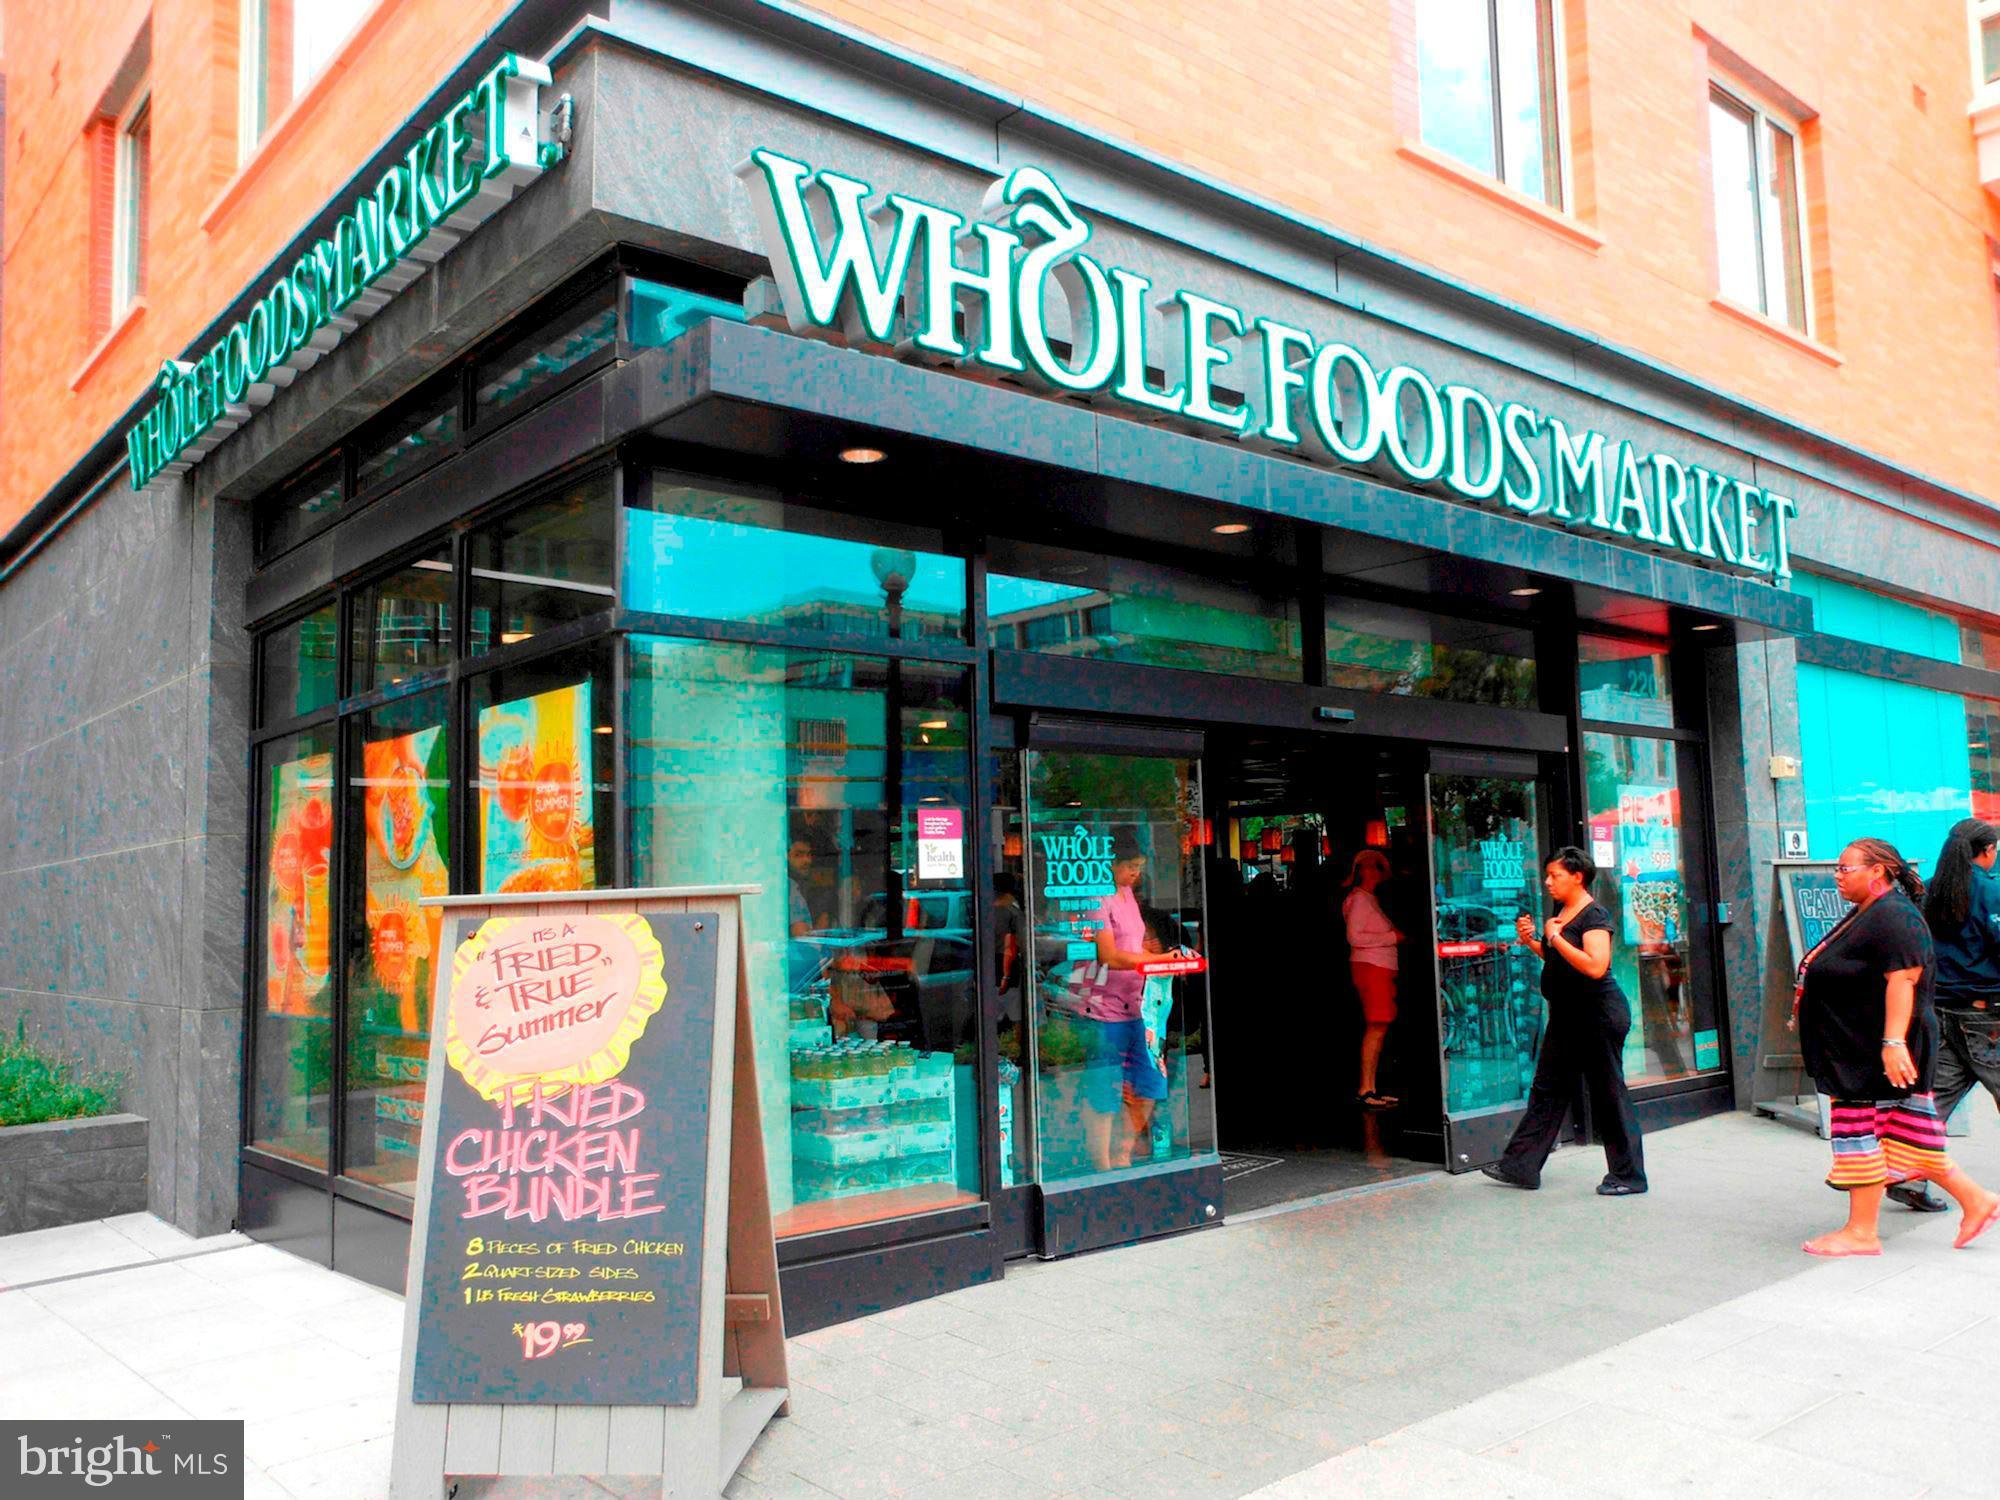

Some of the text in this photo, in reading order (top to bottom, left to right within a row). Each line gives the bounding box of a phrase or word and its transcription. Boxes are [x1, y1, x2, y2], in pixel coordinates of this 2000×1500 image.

[125, 52, 522, 491] WHOLE FOODS MARKET
[750, 147, 1798, 581] WHOLE FOODS MARKET
[1628, 669, 1659, 699] 220
[534, 795, 570, 812] SUMMER
[1620, 795, 1646, 825] PIE
[927, 851, 956, 862] health
[1041, 825, 1116, 860] WHOLE
[1480, 833, 1525, 860] WHOLE
[1046, 861, 1114, 885] FOODS
[1484, 860, 1523, 879] FOODS
[562, 922, 577, 938] A
[477, 992, 619, 1055] Summer
[492, 1076, 645, 1130] FRIED
[445, 1127, 640, 1178] CHICKEN
[461, 1173, 666, 1222] BUNDLE
[465, 1237, 684, 1256] 8 PIECES OF FRIED CHICKEN
[462, 1262, 482, 1280] 2
[588, 1266, 639, 1279] SIDES
[463, 1287, 473, 1305] 1
[497, 1286, 541, 1303] FRESH
[541, 1287, 656, 1304] STRAWBERRIES
